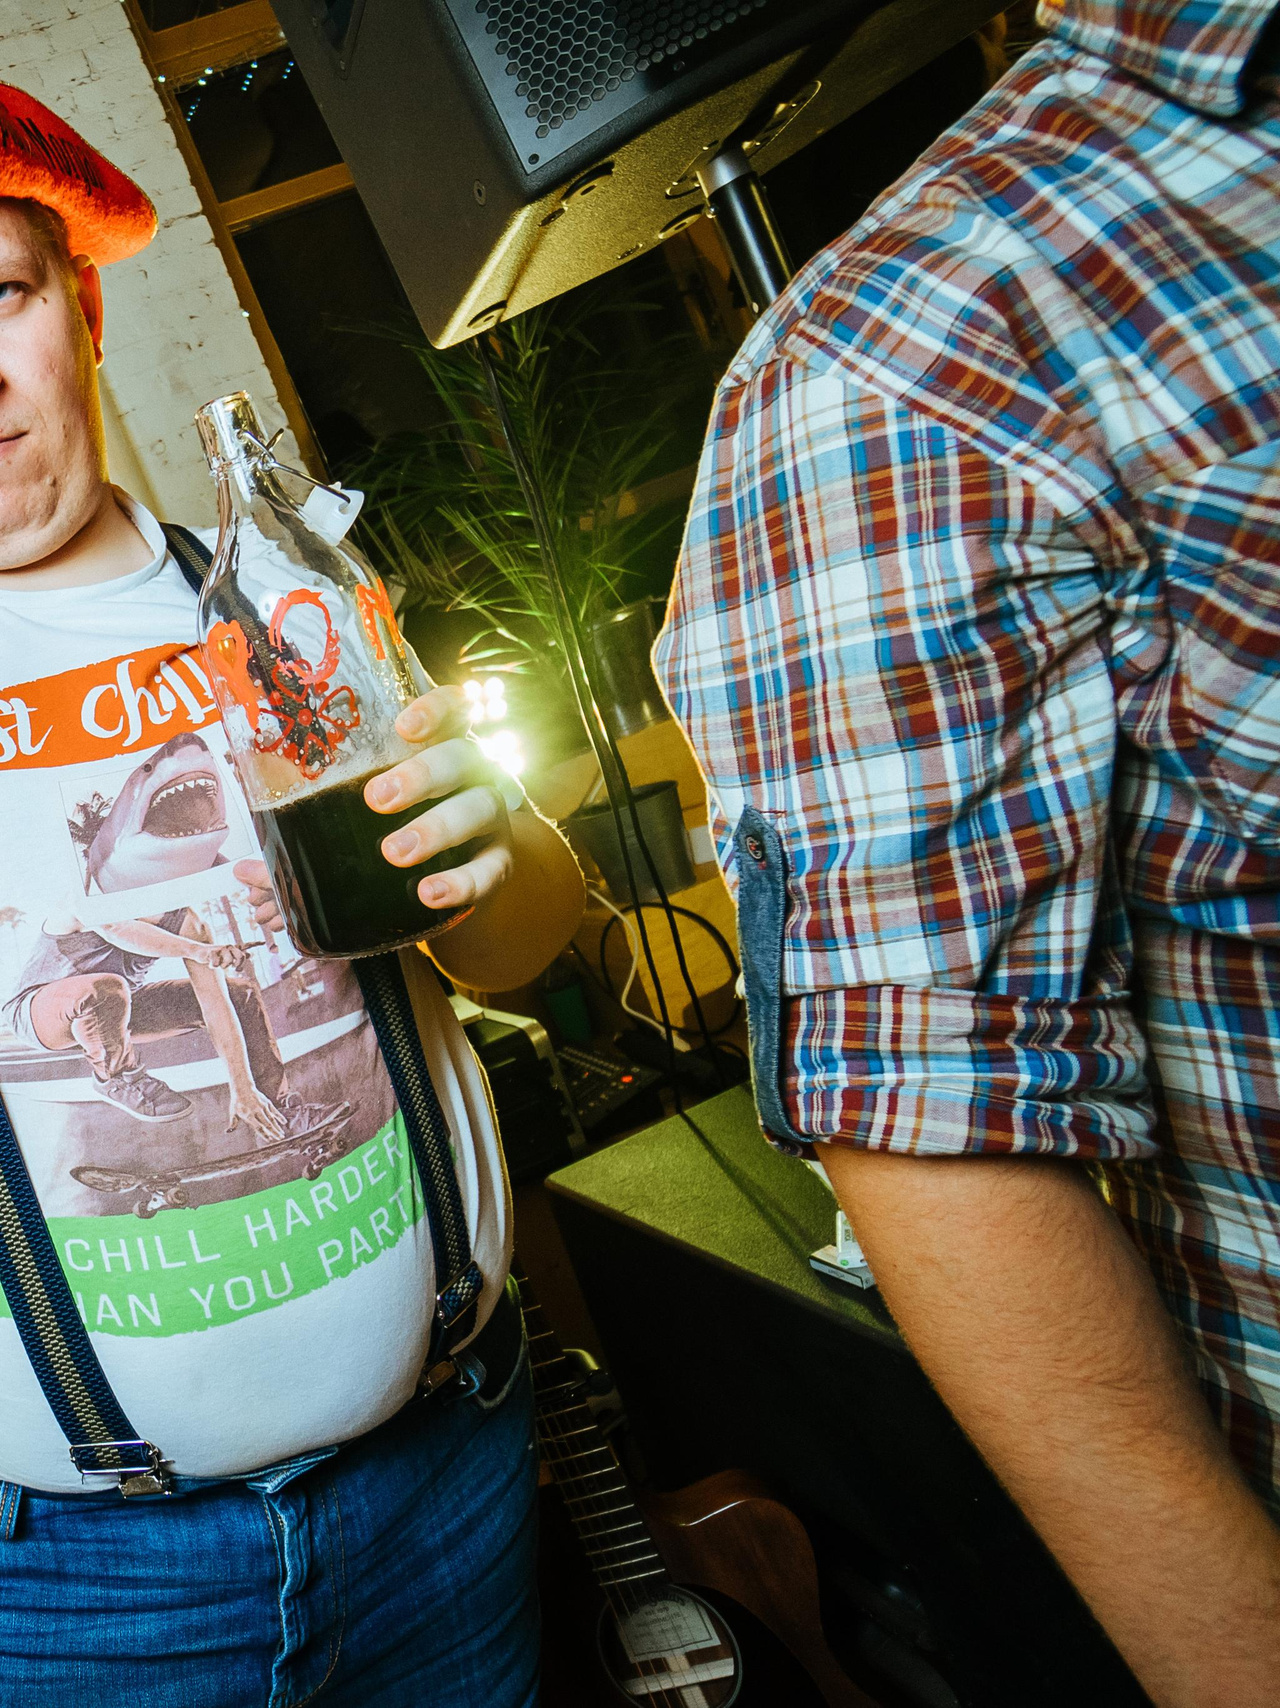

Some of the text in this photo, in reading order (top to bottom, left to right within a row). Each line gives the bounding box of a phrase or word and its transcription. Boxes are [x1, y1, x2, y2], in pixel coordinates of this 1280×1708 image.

[81, 651, 219, 748] Chill
[64, 1129, 404, 1273] CHILL HARDER
[189, 1261, 295, 1320] YOU
